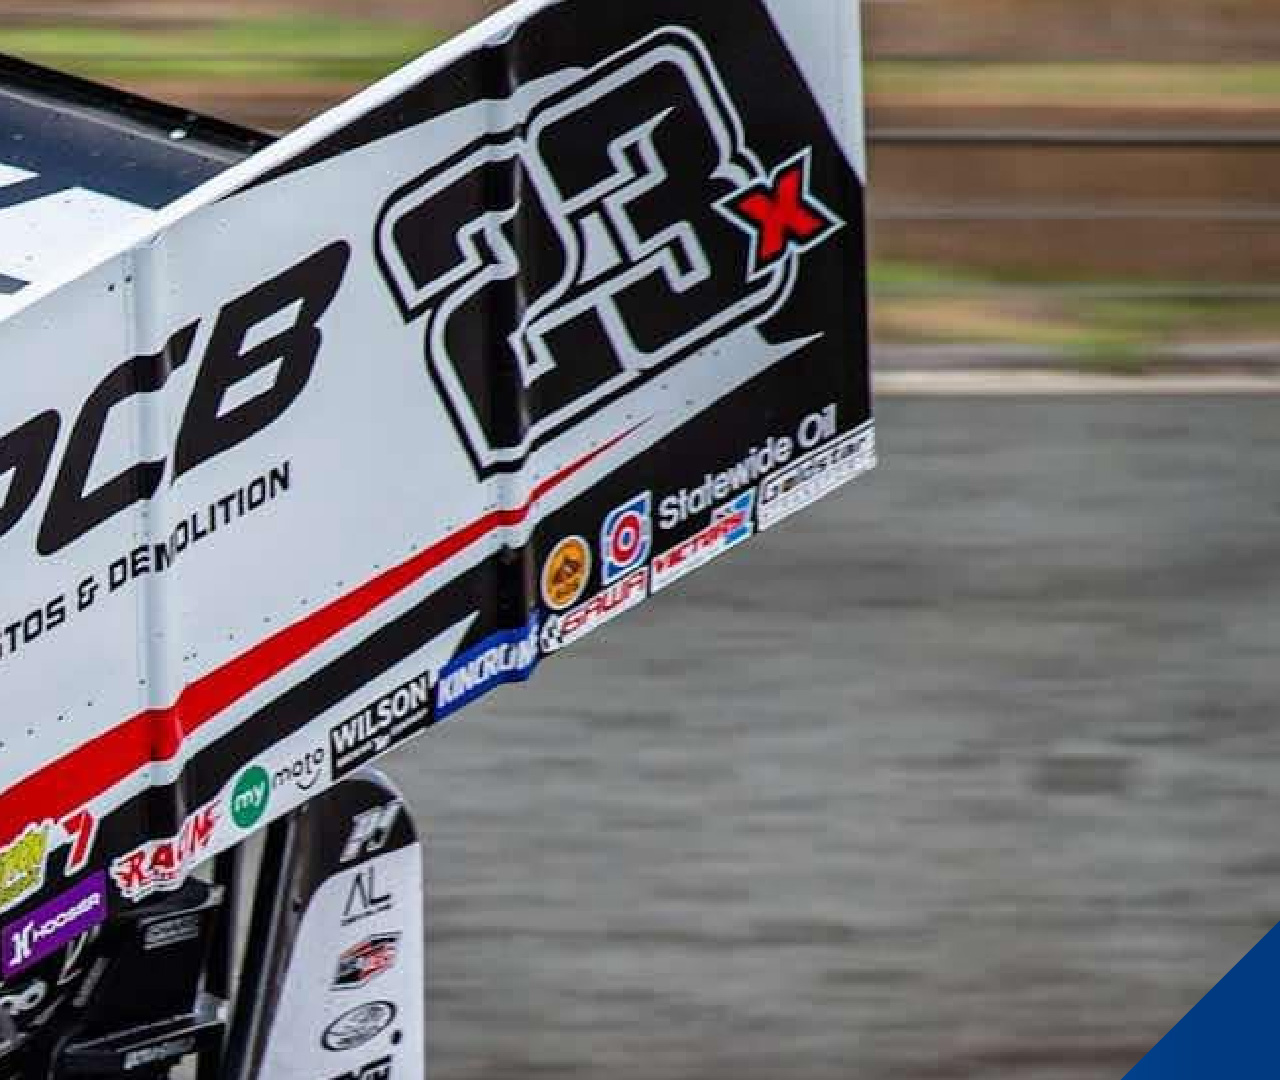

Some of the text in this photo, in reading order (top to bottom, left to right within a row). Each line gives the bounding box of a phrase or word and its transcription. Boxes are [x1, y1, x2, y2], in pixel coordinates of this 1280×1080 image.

[659, 435, 793, 530] Statewide
[76, 566, 100, 612] &
[108, 460, 292, 594] DEMOLITION
[332, 676, 428, 752] WILSON
[232, 747, 325, 812] my moto
